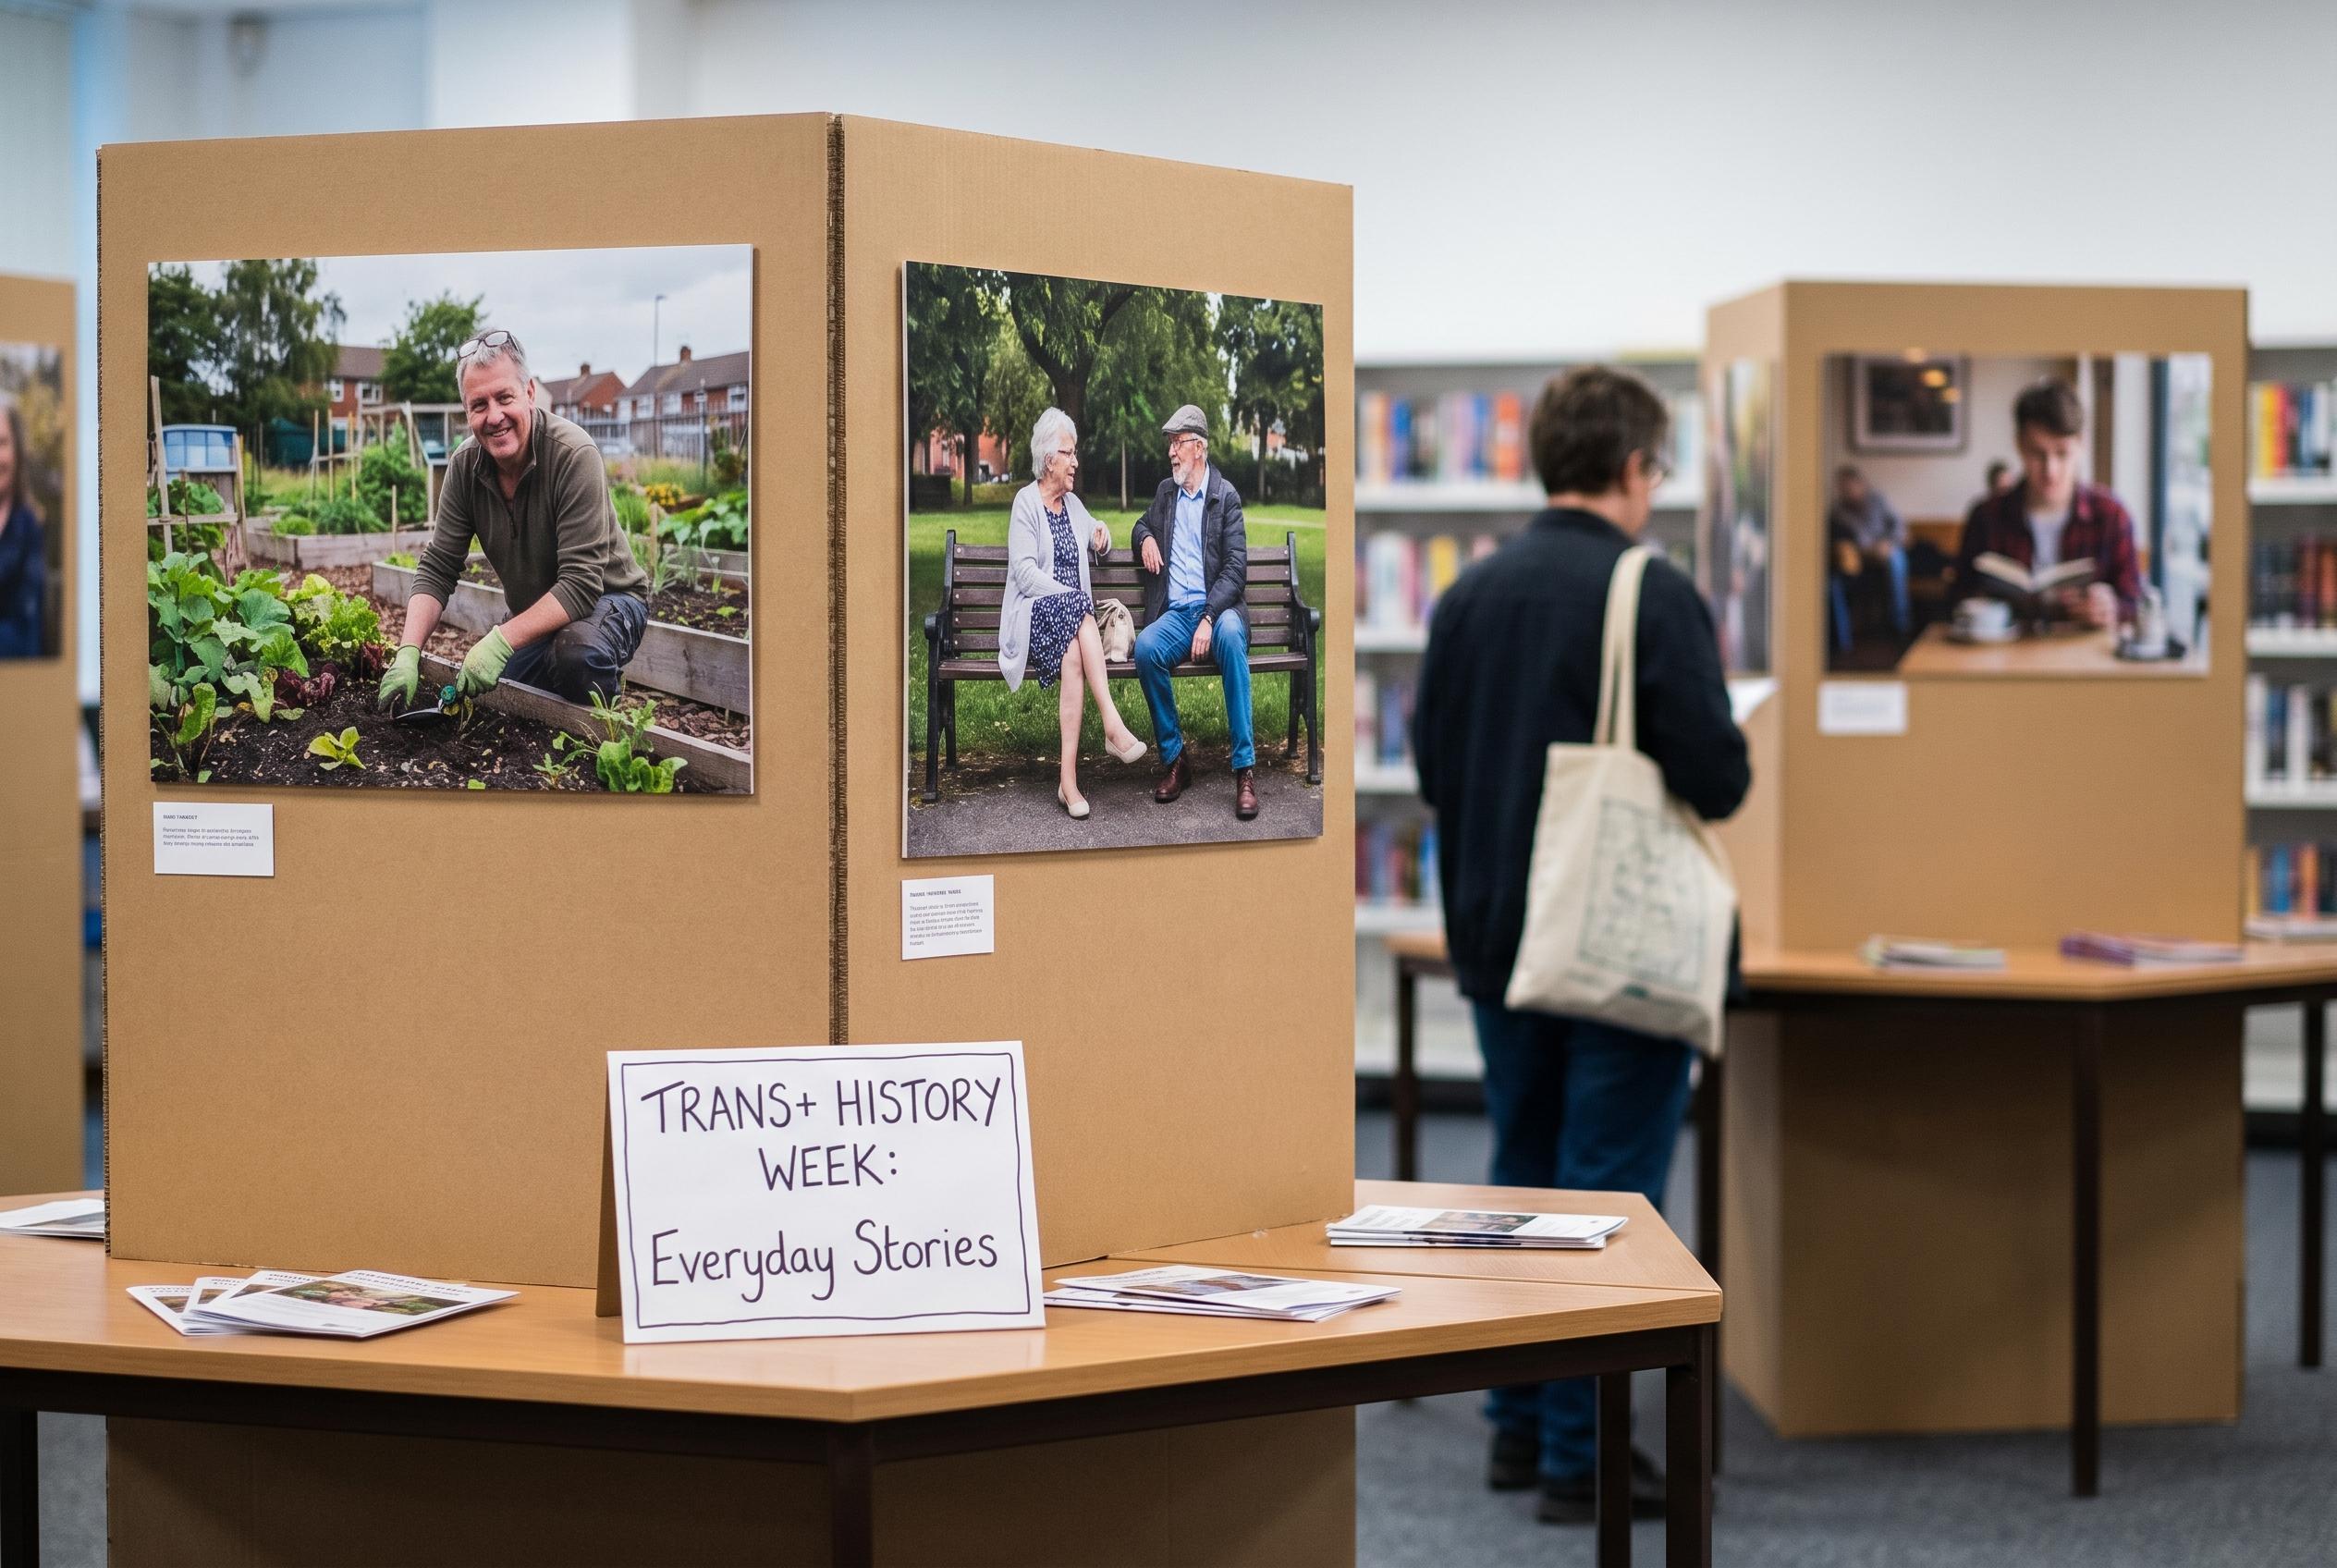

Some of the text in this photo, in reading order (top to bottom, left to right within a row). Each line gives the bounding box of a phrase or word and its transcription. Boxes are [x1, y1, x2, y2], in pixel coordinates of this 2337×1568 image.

[641, 1077, 1000, 1133] TRANS+ HISTORY
[759, 1144, 897, 1191] WEEK:
[653, 1219, 997, 1303] Everyday Stories
